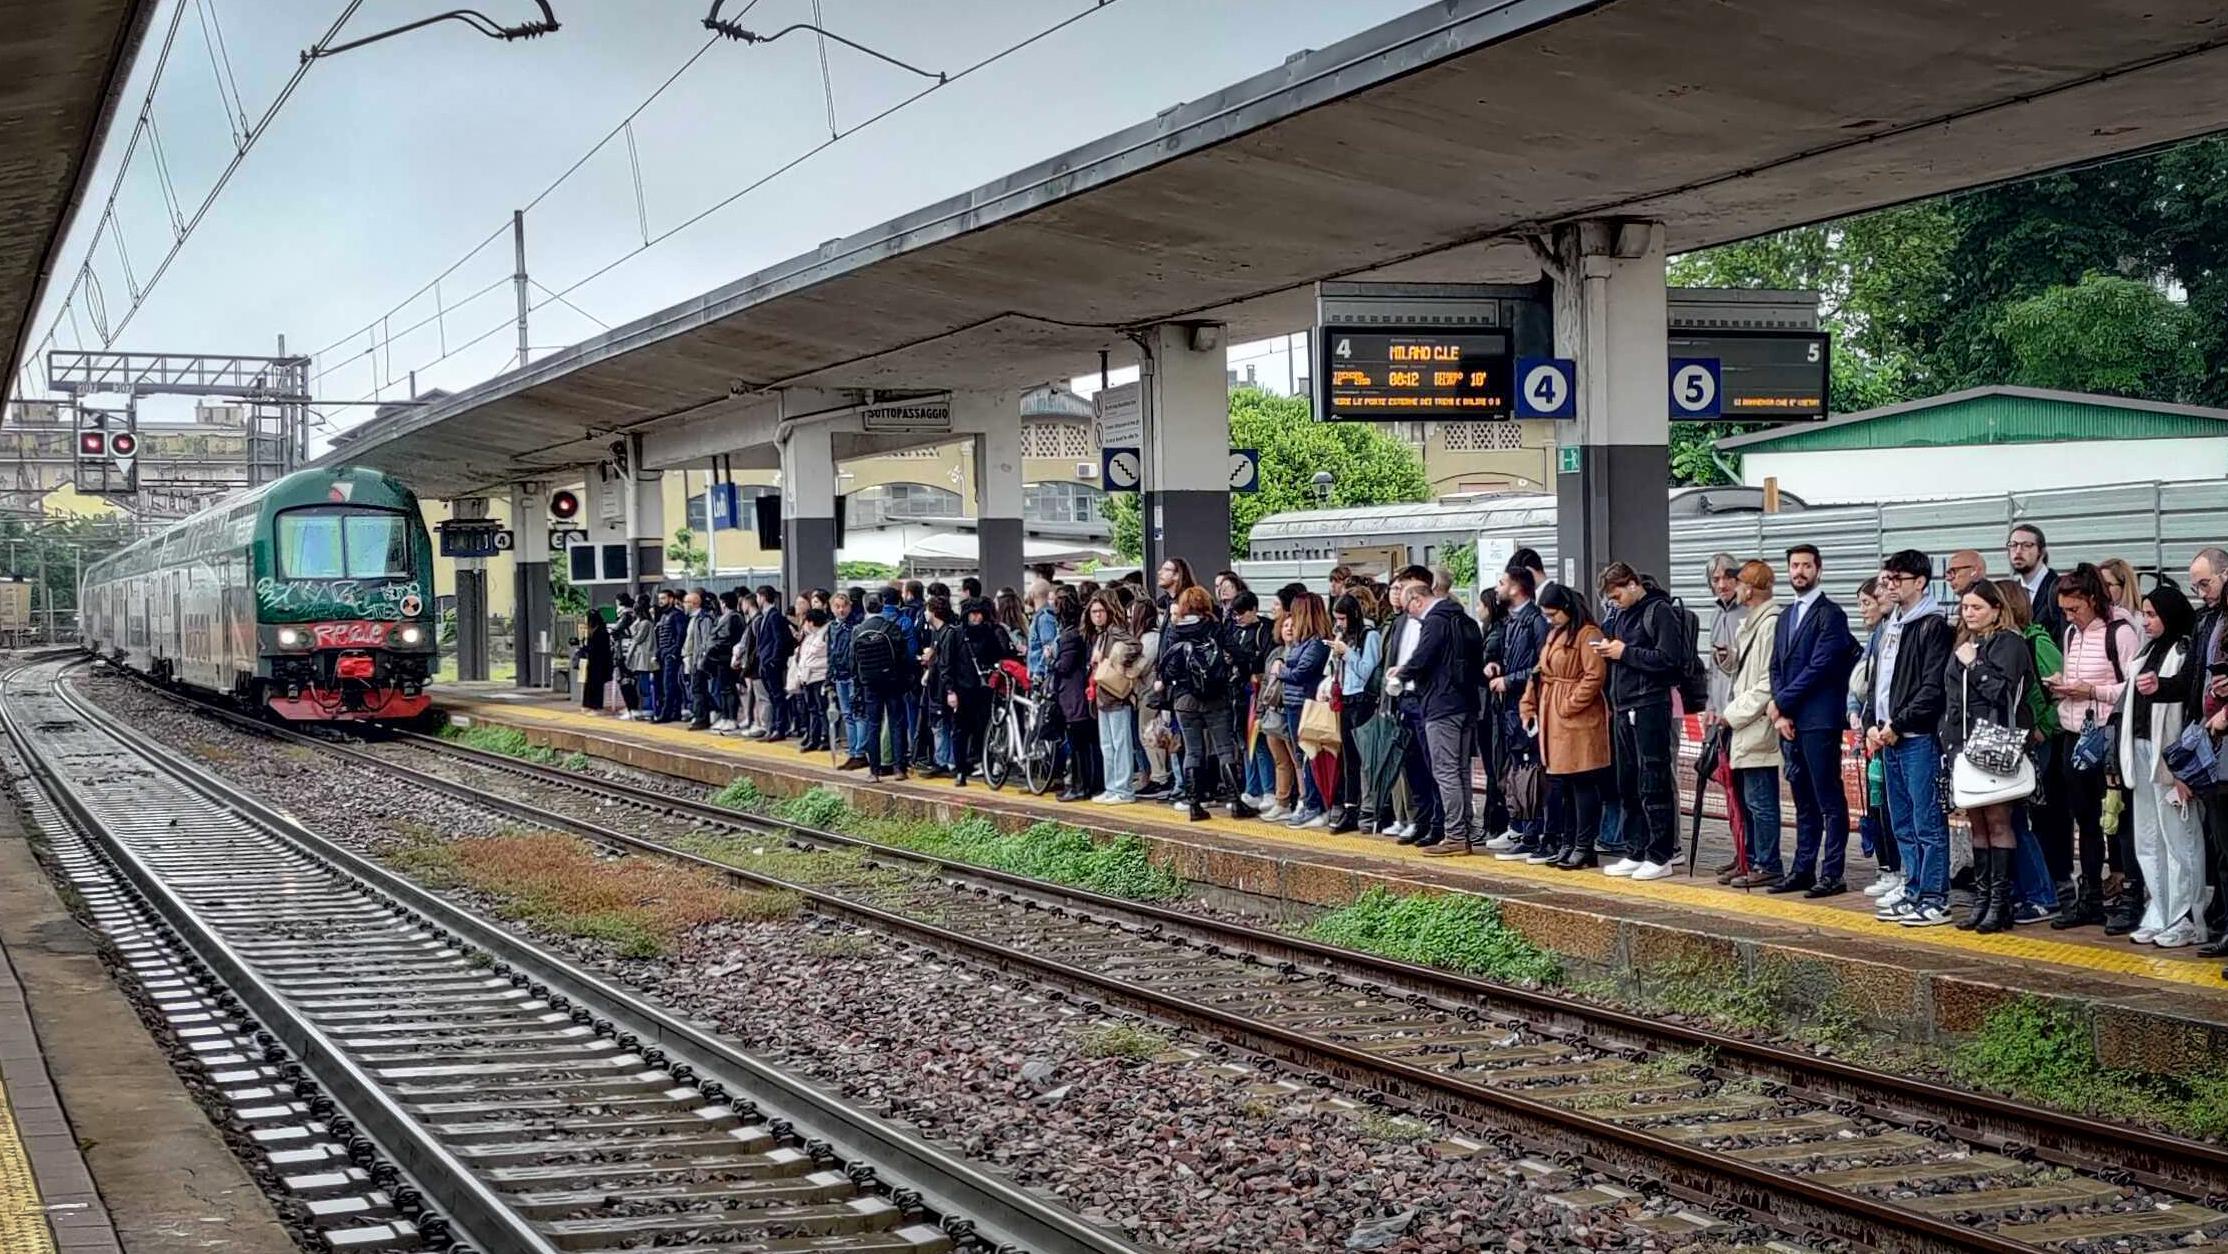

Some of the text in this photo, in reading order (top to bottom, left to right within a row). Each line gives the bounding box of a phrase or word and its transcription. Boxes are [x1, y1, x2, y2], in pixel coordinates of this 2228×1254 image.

[1336, 338, 1352, 359] 4
[1389, 345, 1431, 361] MILANO
[1807, 343, 1820, 363] 5
[1534, 375, 1556, 404] 4
[1685, 375, 1705, 403] 5
[497, 535, 506, 548] 4
